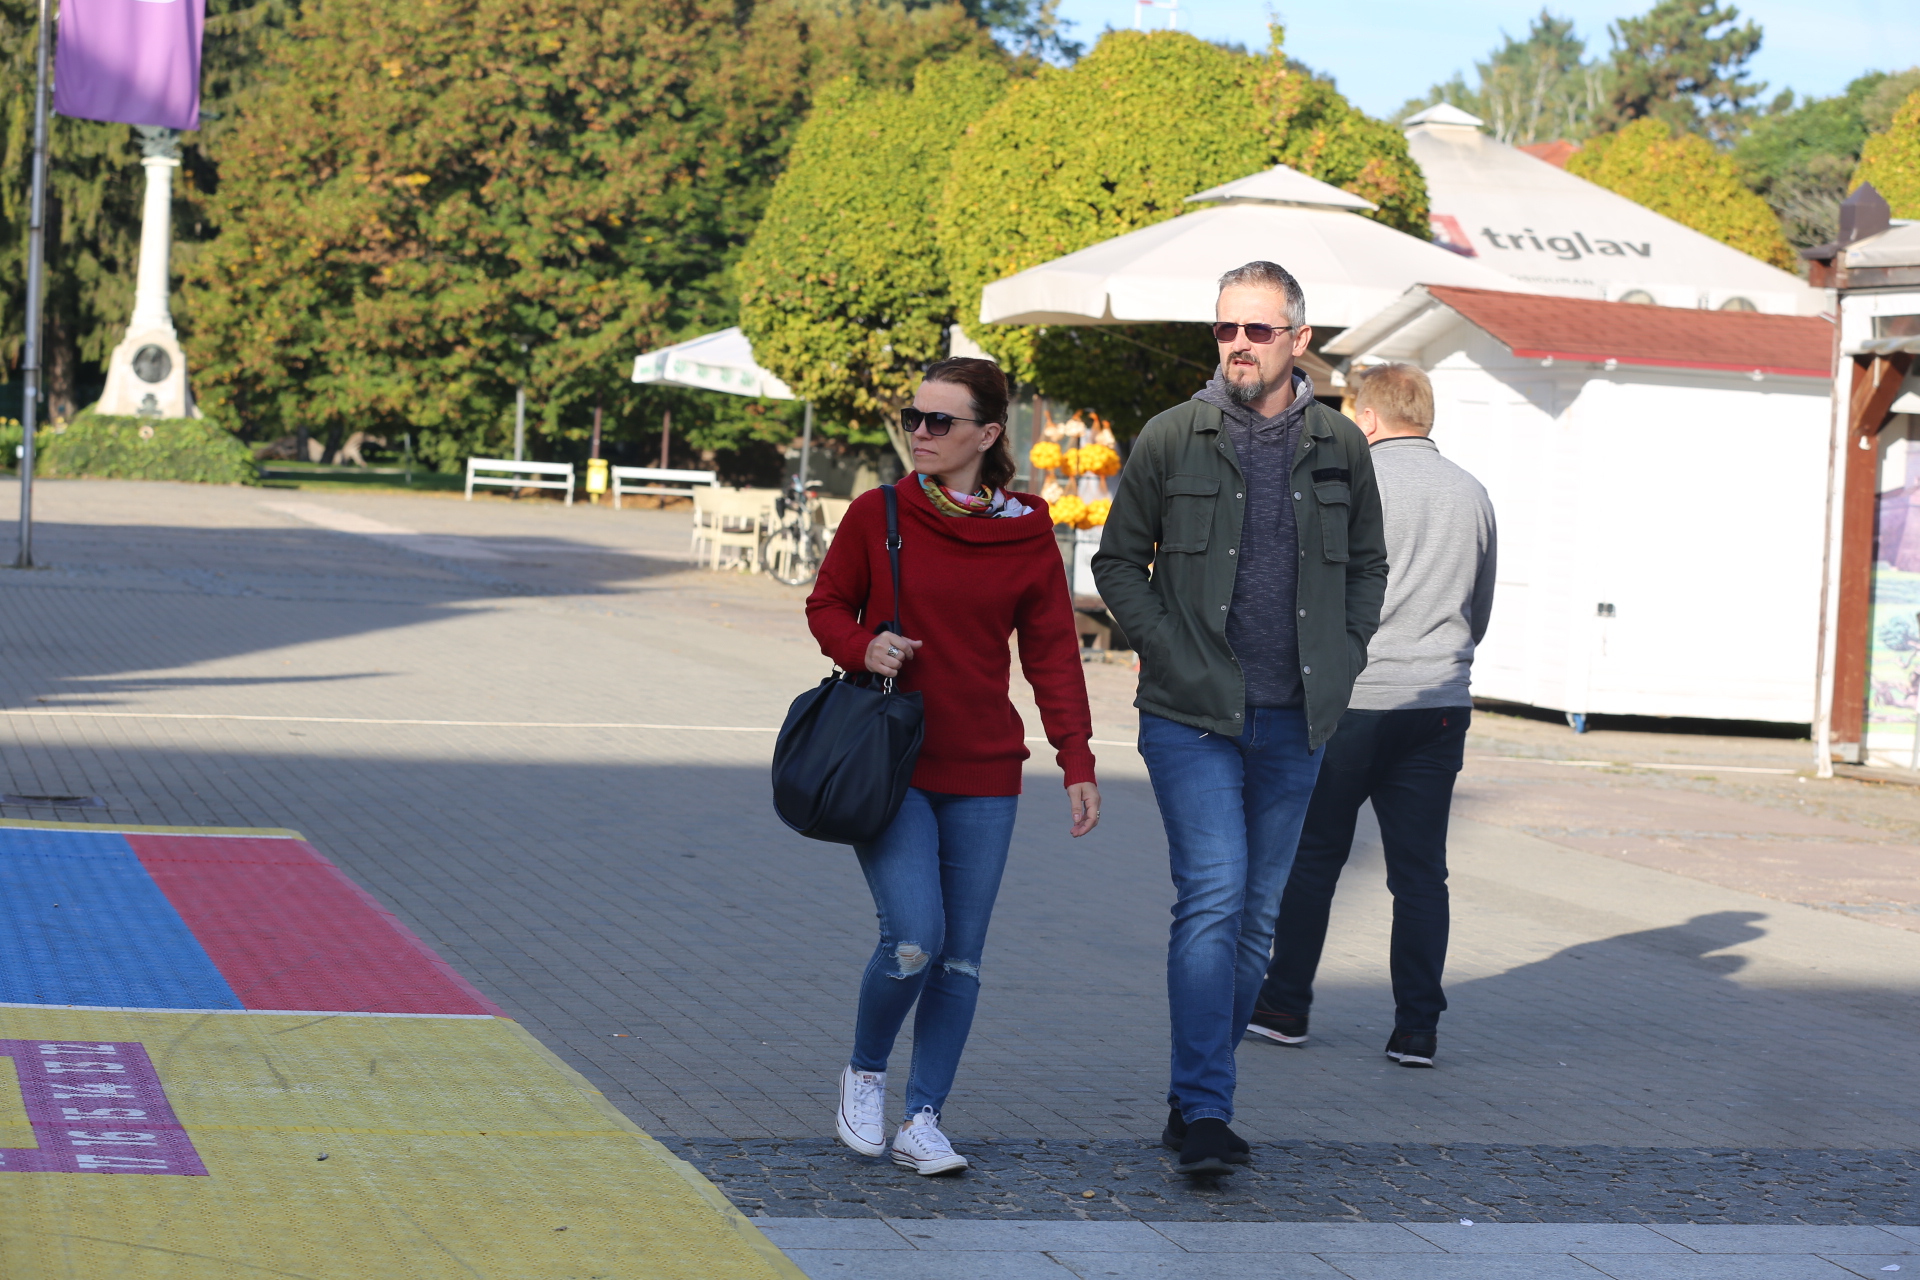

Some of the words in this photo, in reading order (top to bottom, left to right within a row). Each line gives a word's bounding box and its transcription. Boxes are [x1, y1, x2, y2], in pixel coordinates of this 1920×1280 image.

[1480, 227, 1651, 260] triglav
[38, 1044, 117, 1055] 12
[43, 1060, 125, 1074] 13
[50, 1082, 135, 1099] 14
[61, 1107, 147, 1120] 15
[67, 1130, 158, 1146] 16
[76, 1154, 168, 1169] 17
